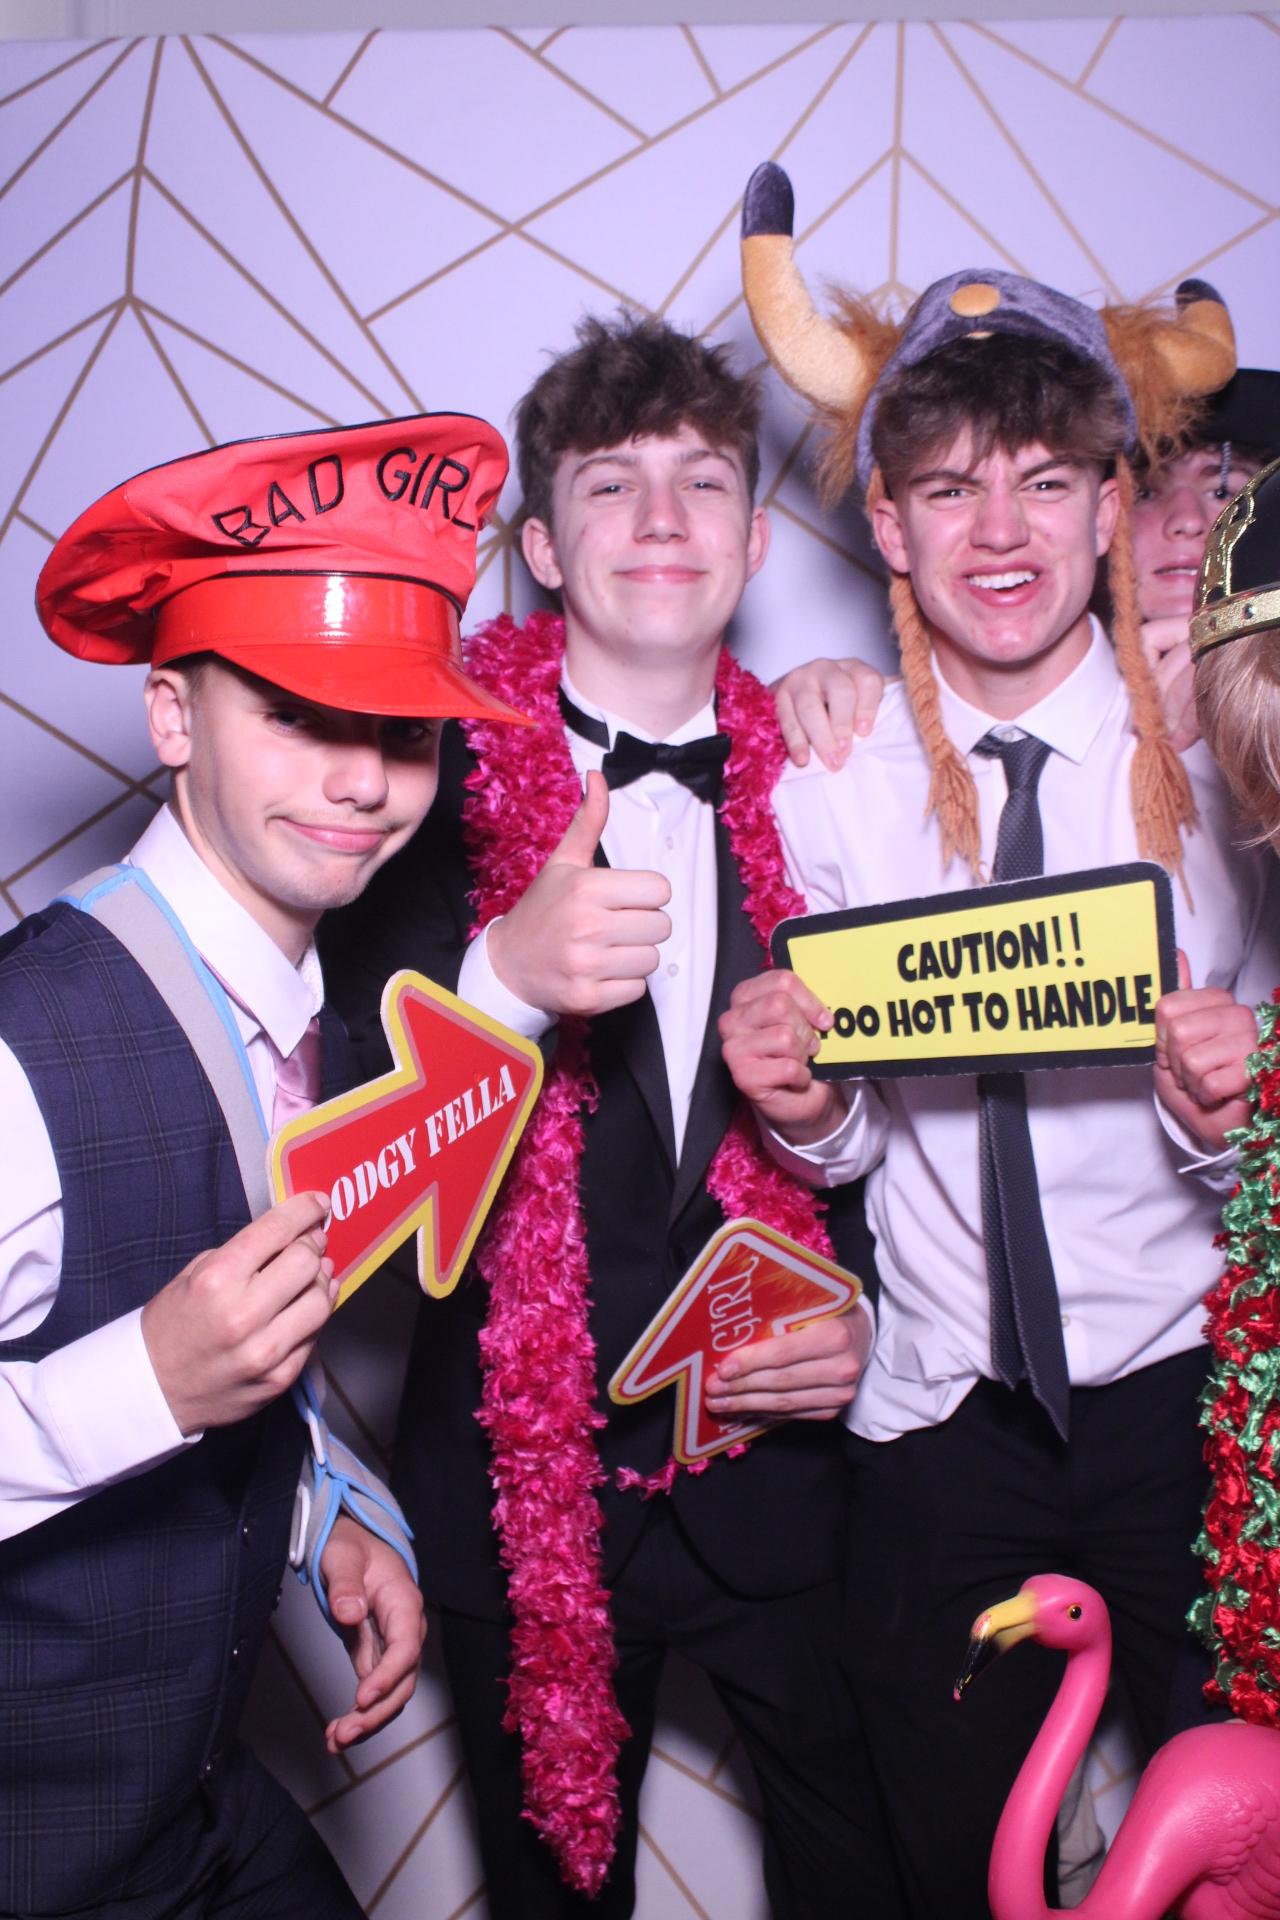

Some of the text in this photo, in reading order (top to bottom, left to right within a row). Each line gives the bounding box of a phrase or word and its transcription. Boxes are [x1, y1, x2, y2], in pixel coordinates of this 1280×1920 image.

[212, 454, 345, 547] BAD
[897, 912, 1085, 982] CAUTION!!
[820, 974, 1157, 1040] OO HOT TO HANDLE
[322, 1064, 517, 1234] ODGY FELLA
[707, 1255, 762, 1352] GIRL
